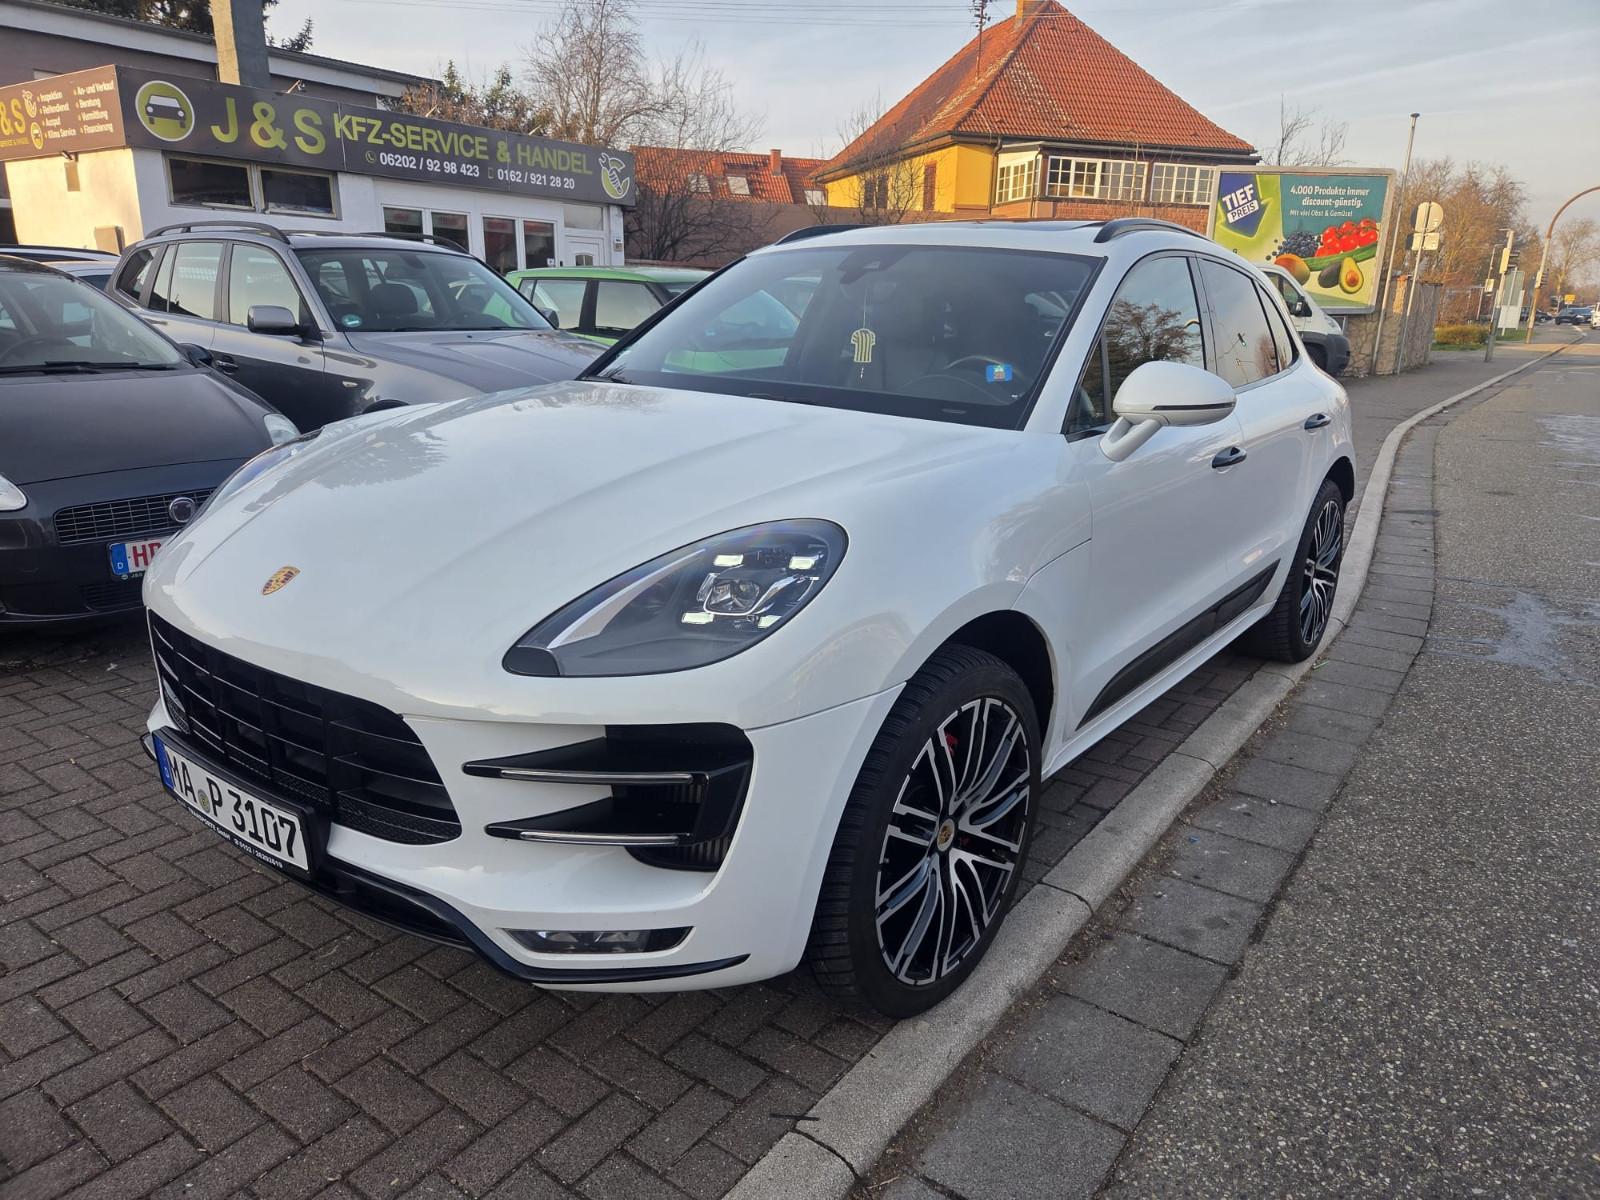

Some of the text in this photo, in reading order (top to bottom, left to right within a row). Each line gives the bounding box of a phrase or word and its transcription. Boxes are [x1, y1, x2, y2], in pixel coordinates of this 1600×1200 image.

[333, 113, 593, 175] KFZ-SERVICE & HANDEL
[379, 152, 480, 178] 06202 / 92 98 423
[497, 168, 575, 190] 0162 / 921 28 20
[1222, 183, 1254, 211] TIEF
[1290, 185, 1370, 196] 4.000 Produkte immer
[1230, 202, 1256, 221] PREIS
[1302, 196, 1363, 208] discount-günstig.
[1310, 209, 1324, 217] Obst
[116, 562, 124, 570] D
[166, 750, 198, 803] MA
[206, 776, 223, 818] P
[227, 789, 298, 858] 3107
